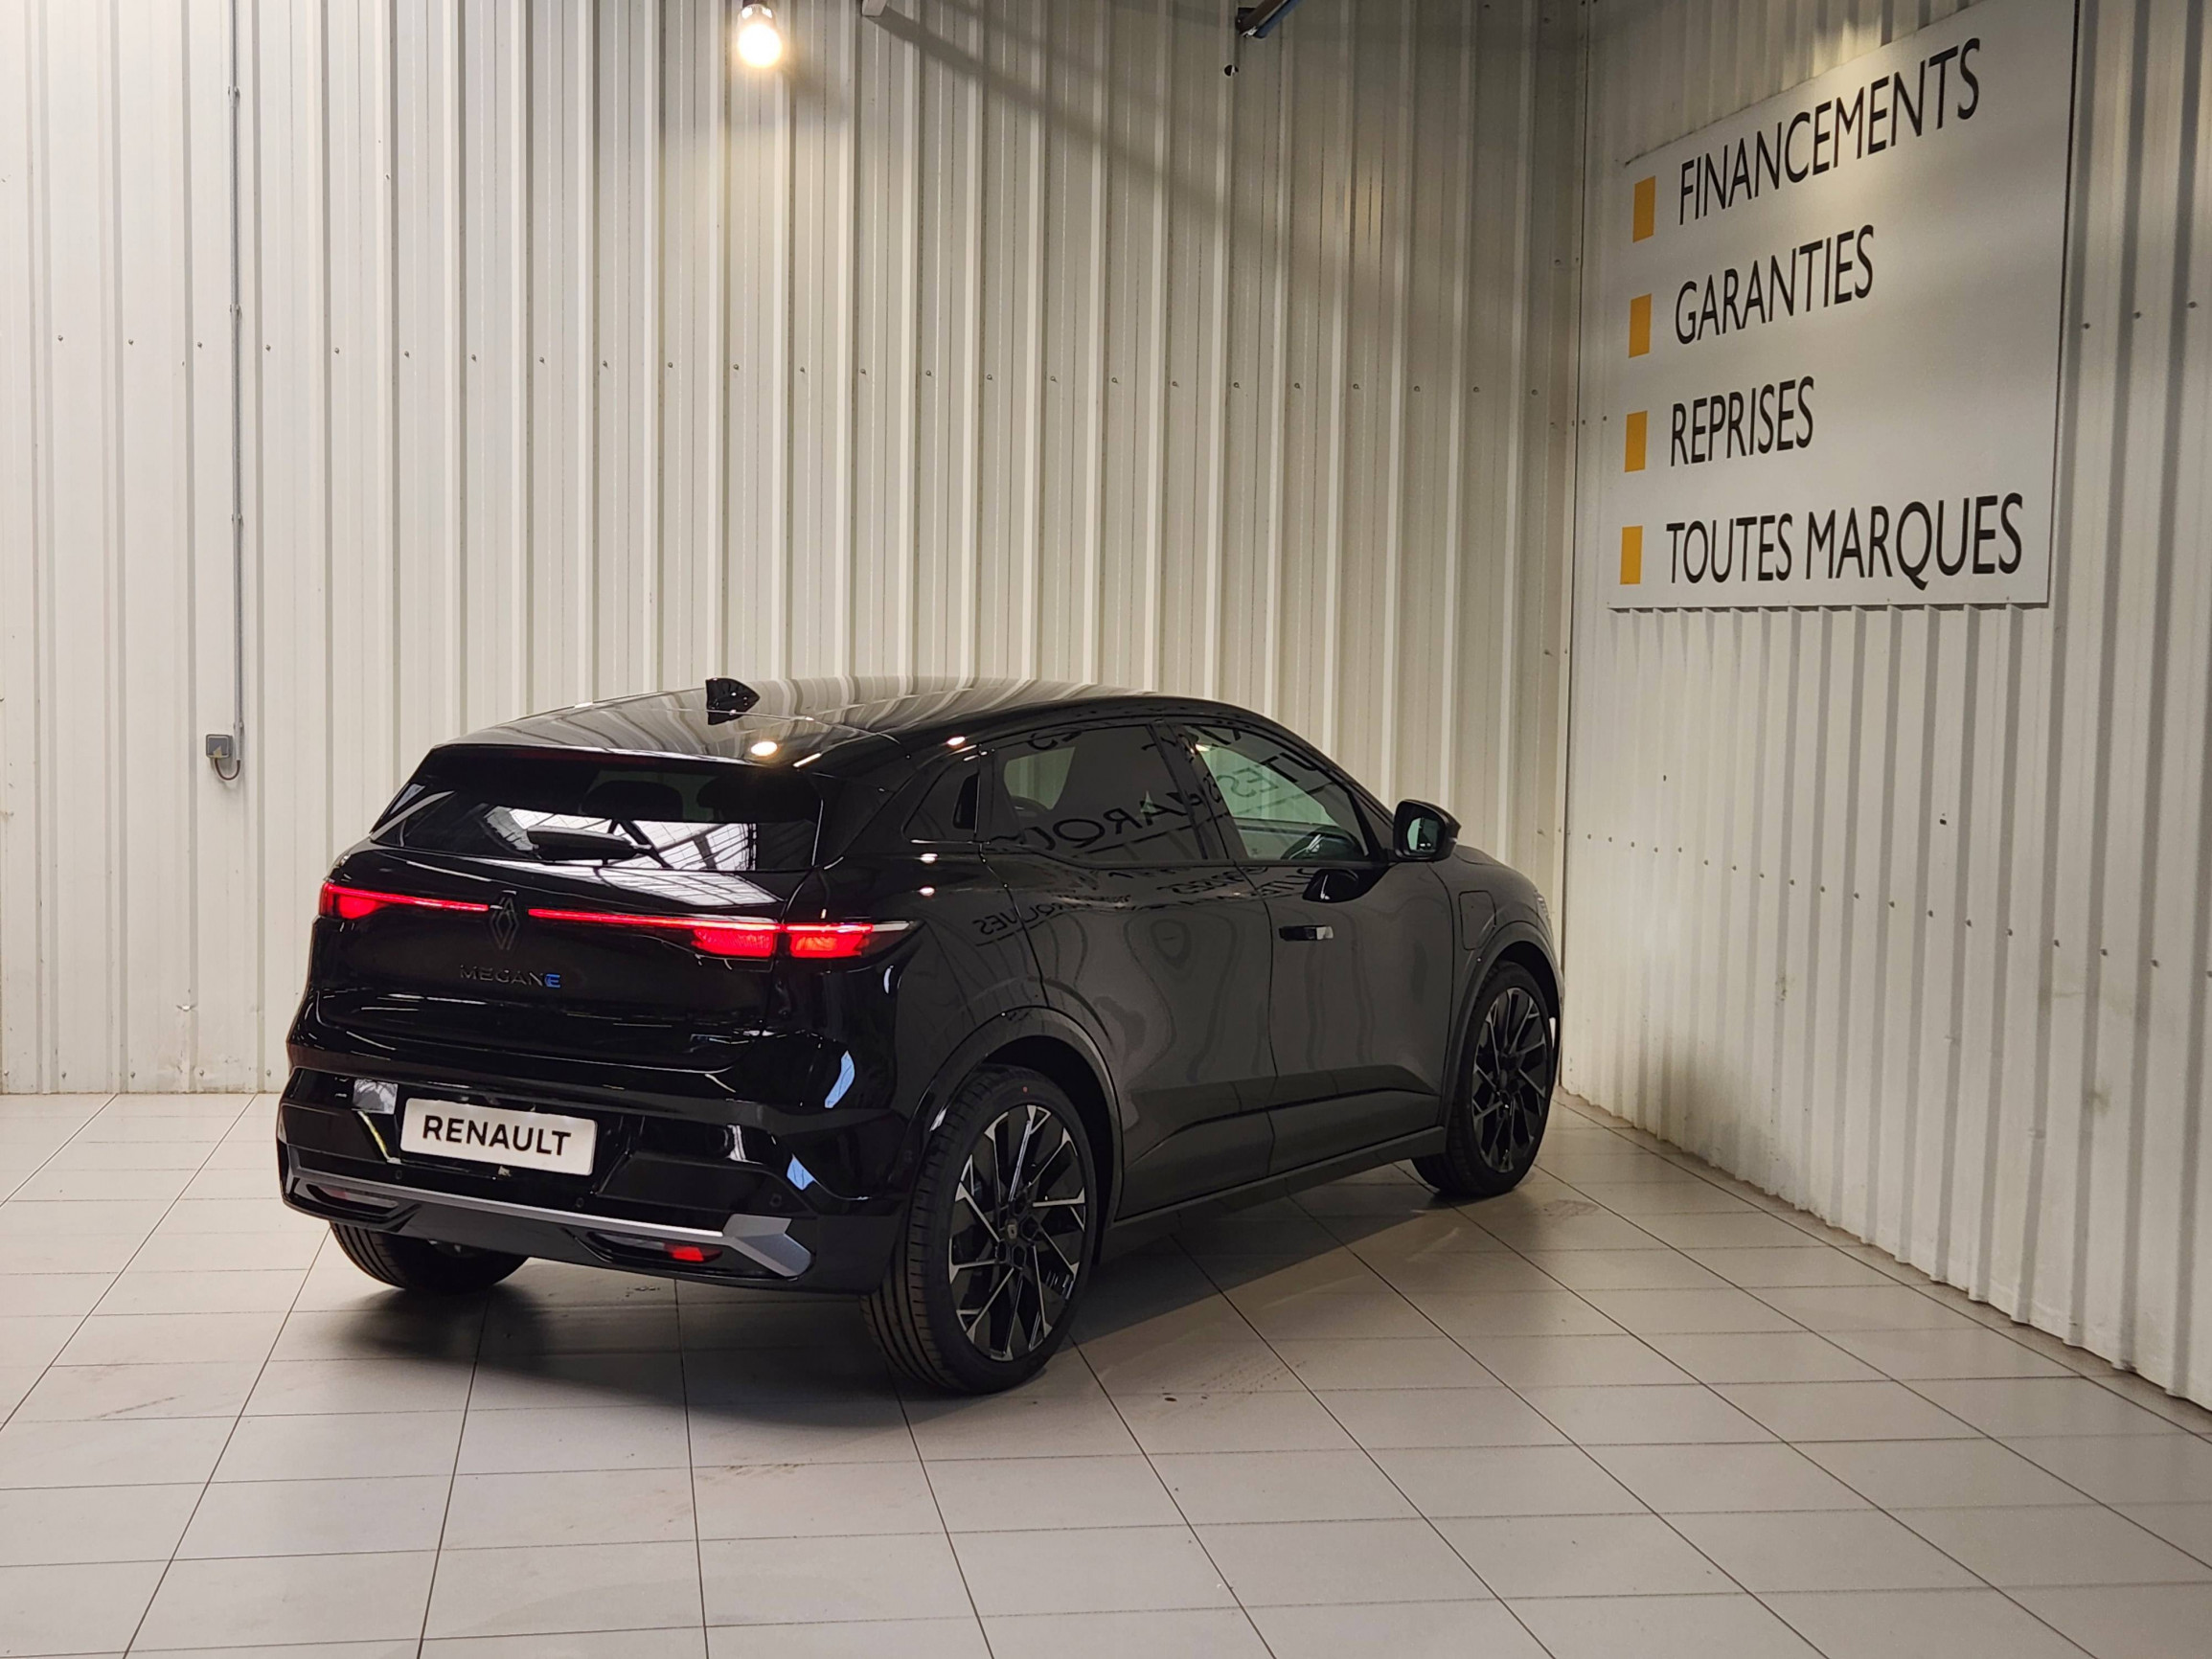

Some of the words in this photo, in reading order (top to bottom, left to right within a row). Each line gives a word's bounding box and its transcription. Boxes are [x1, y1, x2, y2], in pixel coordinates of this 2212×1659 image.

[1678, 37, 1981, 226] FINANCEMENTS
[1675, 224, 1875, 346] GARANTIES
[1670, 375, 1815, 467] REPRISES
[1665, 512, 1792, 584] TOUTES
[1805, 491, 2024, 592] MARQUES
[422, 1114, 572, 1157] RENAULT
